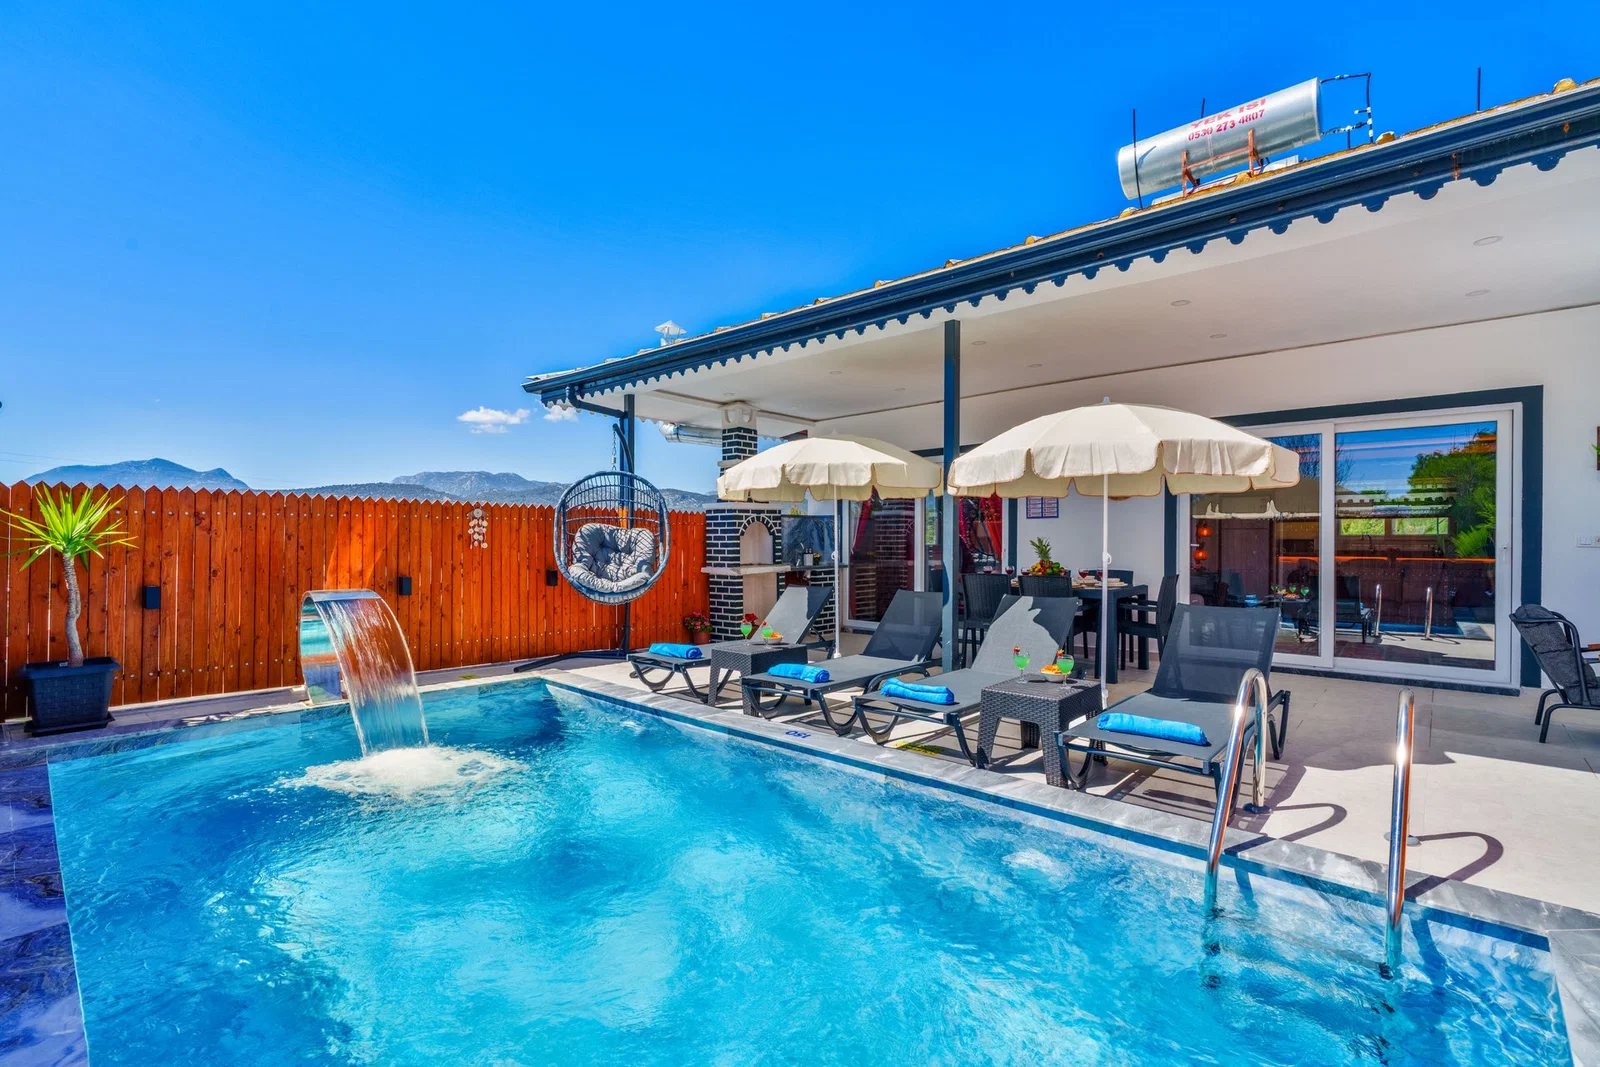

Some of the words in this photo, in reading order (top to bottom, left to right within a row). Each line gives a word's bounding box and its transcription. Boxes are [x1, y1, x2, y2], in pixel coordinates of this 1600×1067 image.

[1188, 127, 1213, 141] 0530
[1216, 120, 1236, 133] 273
[1238, 109, 1265, 124] 4807
[1191, 112, 1231, 129] YEK
